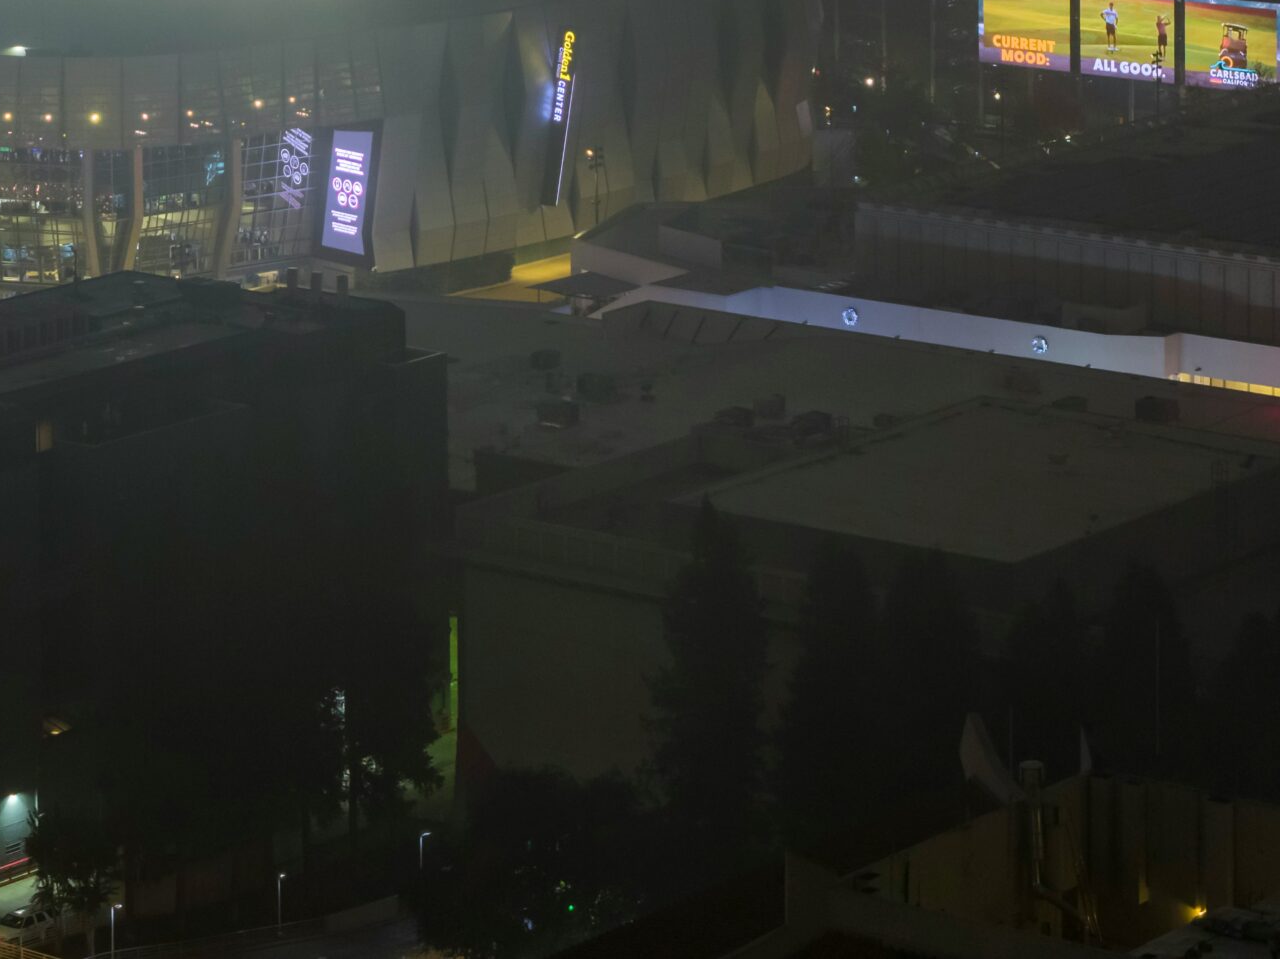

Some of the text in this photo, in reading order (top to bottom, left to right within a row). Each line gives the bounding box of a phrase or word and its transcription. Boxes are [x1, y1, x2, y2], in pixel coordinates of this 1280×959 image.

[992, 34, 1056, 53] CURRENT
[1001, 49, 1050, 66] MOOD:
[1093, 58, 1118, 73] ALL
[1209, 69, 1259, 82] CARLSBAD
[553, 81, 566, 122] CENTER
